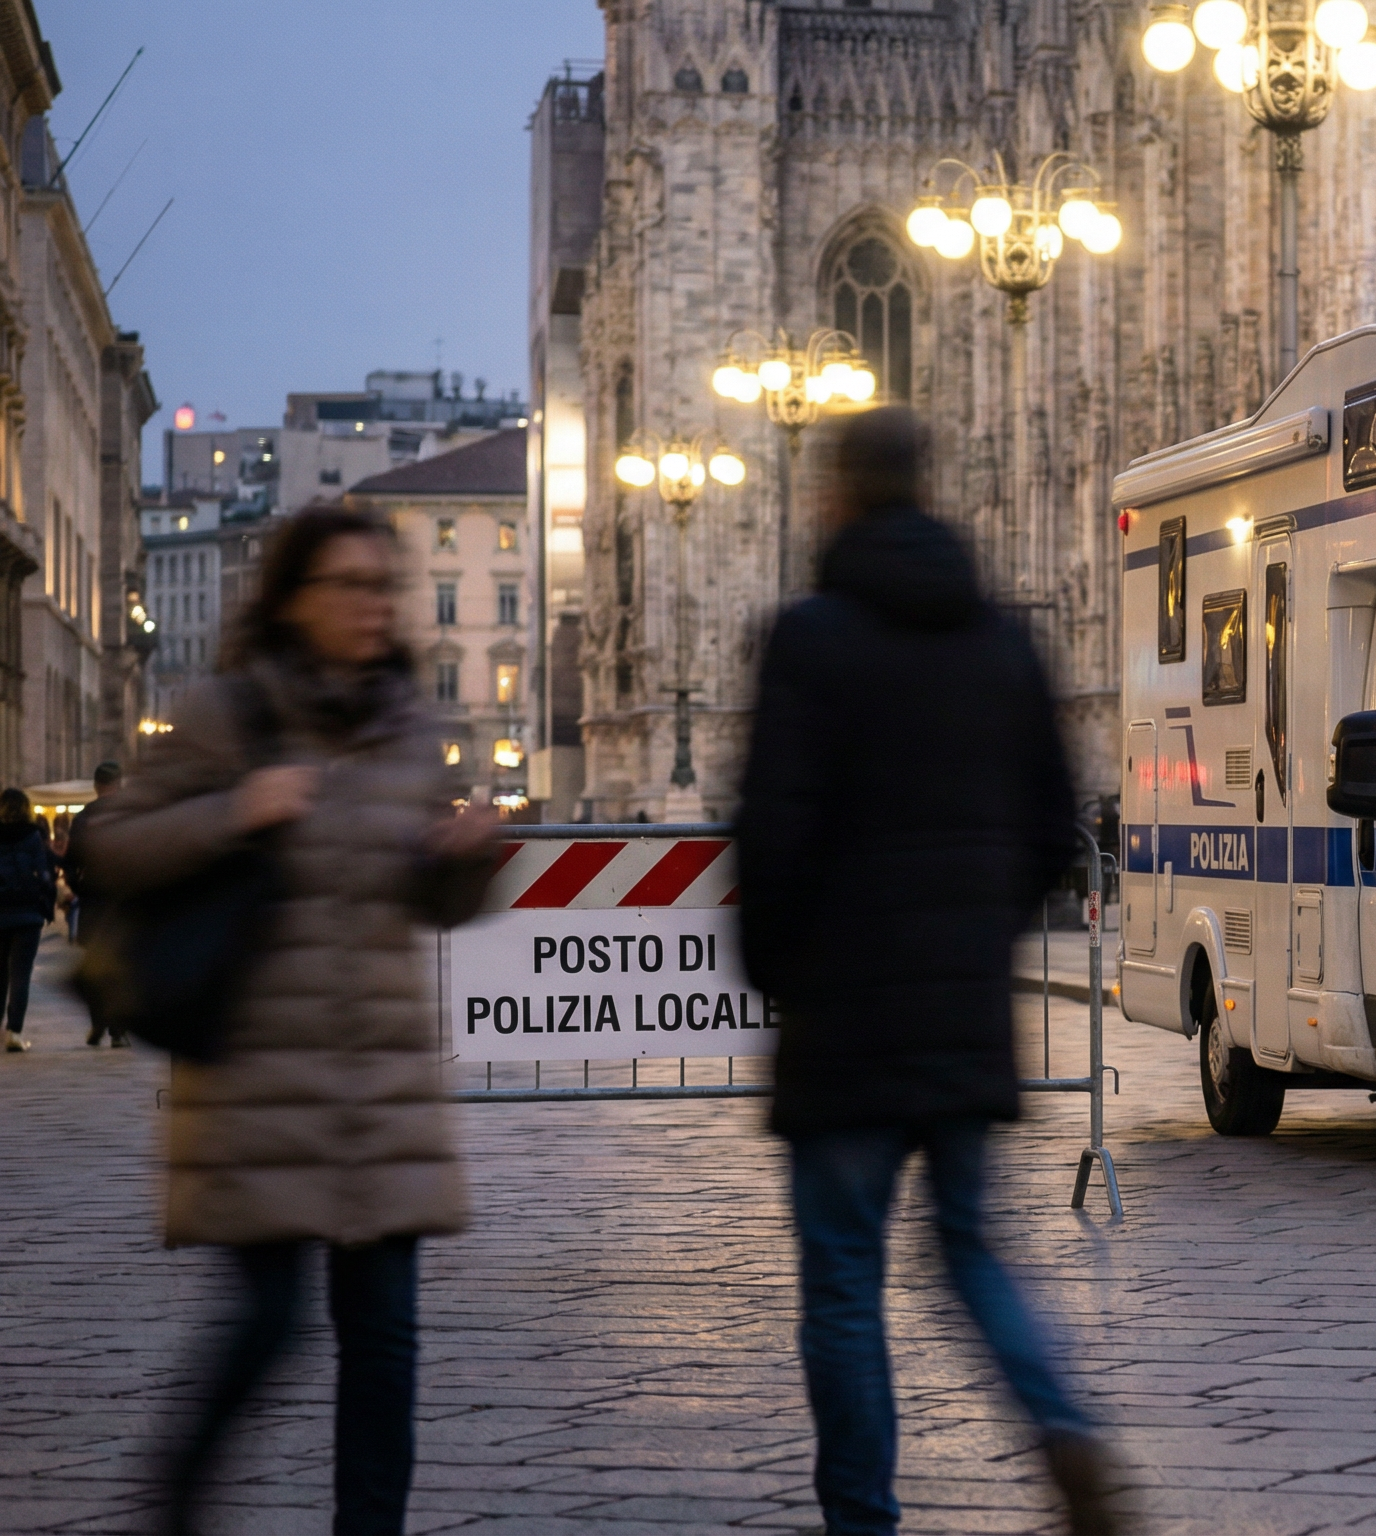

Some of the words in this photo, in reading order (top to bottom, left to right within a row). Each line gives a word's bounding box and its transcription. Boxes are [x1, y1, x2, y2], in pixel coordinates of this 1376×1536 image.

[1190, 832, 1249, 871] POLIZIA
[533, 934, 663, 974] POSTO
[679, 934, 716, 971] DI
[467, 995, 621, 1034] POLIZIA
[635, 992, 782, 1031] LOCALE
